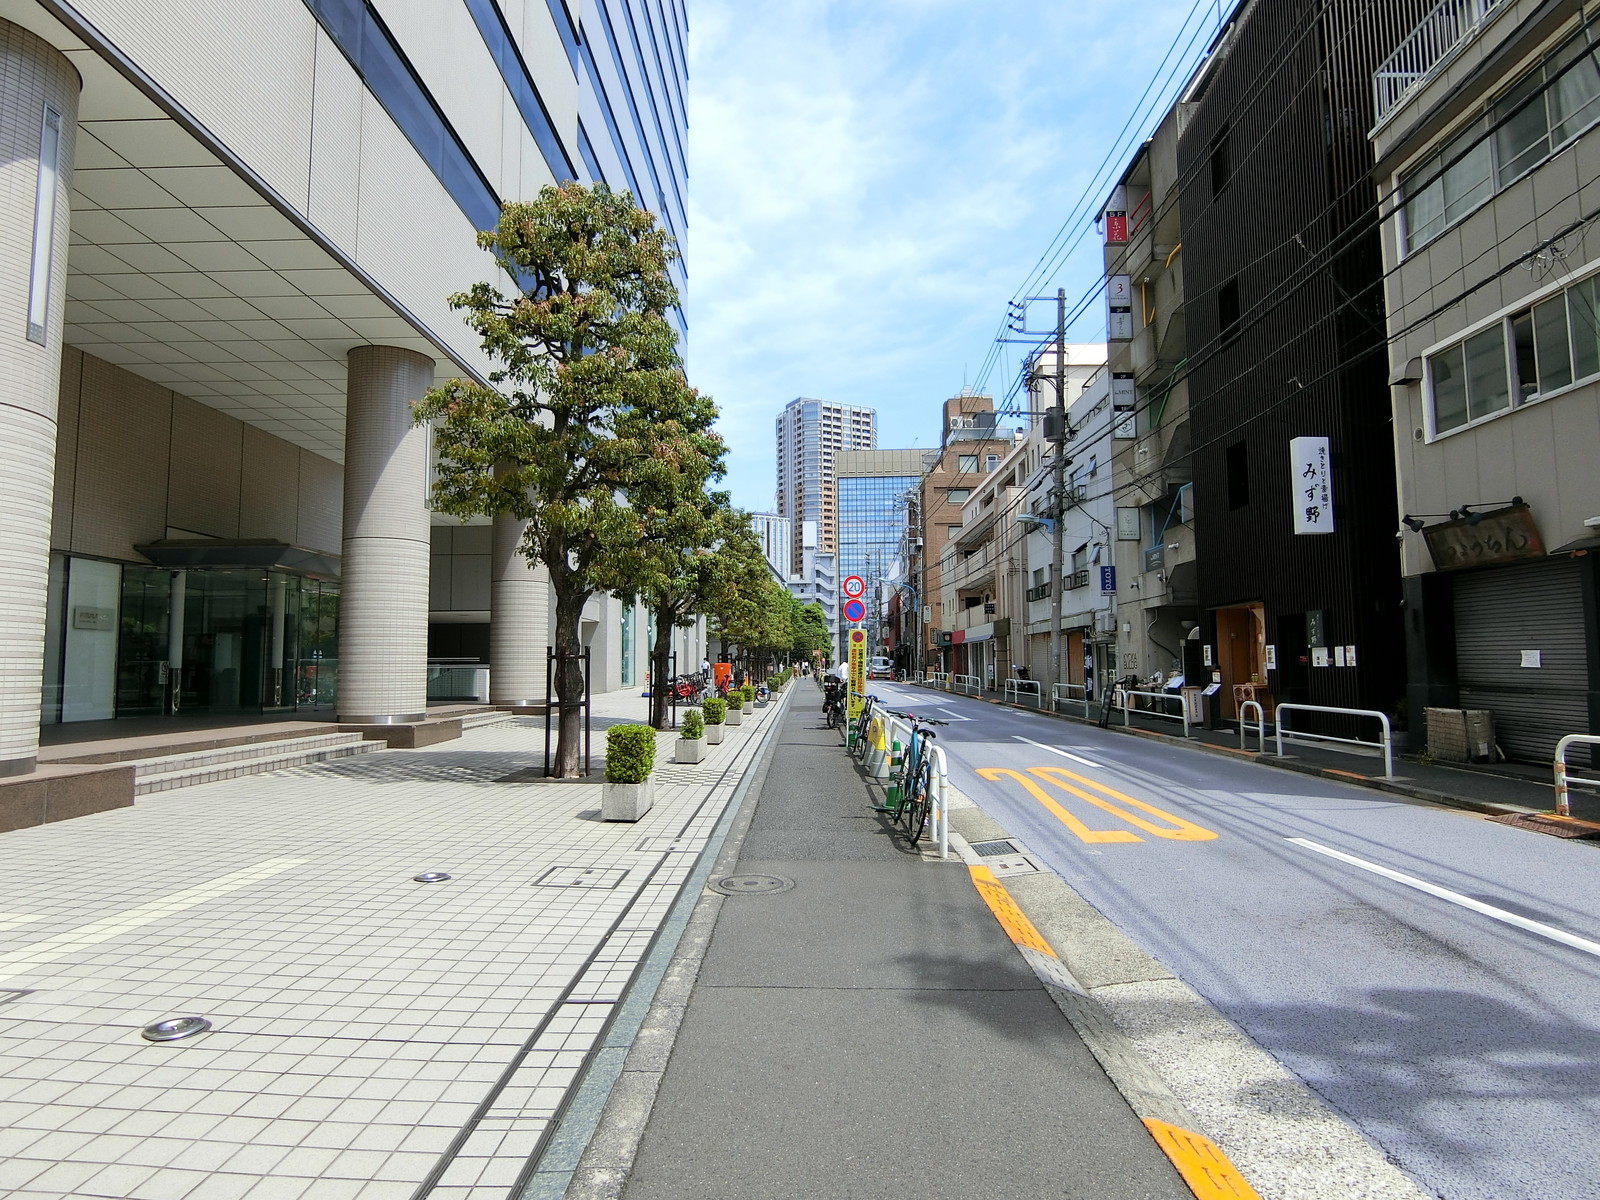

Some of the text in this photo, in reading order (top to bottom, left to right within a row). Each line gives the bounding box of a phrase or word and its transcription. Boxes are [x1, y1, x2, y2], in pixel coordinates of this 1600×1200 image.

[1302, 463, 1320, 523] みず野
[848, 582, 861, 592] 20
[975, 766, 1219, 843] 20
